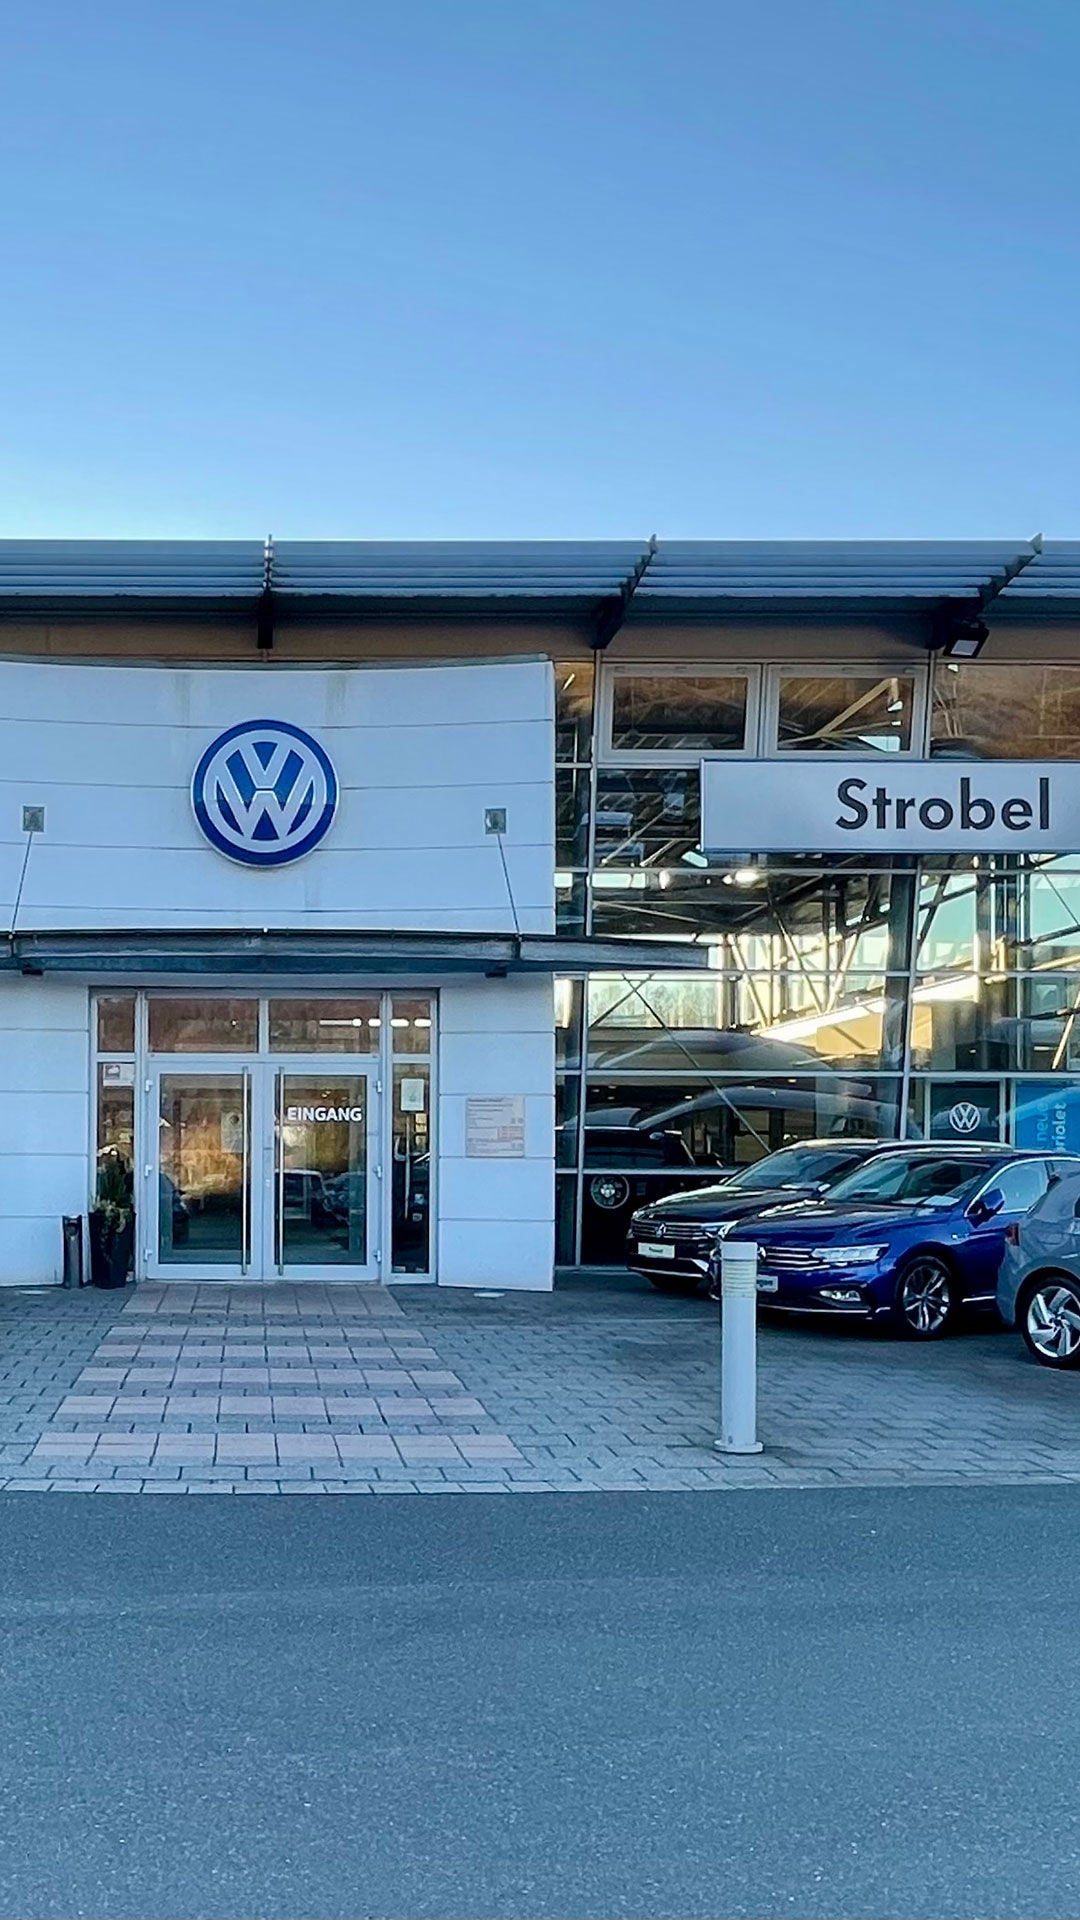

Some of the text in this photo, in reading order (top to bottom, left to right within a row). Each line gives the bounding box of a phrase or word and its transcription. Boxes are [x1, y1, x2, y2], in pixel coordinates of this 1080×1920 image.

[204, 729, 328, 852] VW
[835, 776, 1050, 830] Strobel
[287, 1106, 362, 1121] EINGANG
[950, 1102, 980, 1132] VW
[1036, 1102, 1049, 1141] neue
